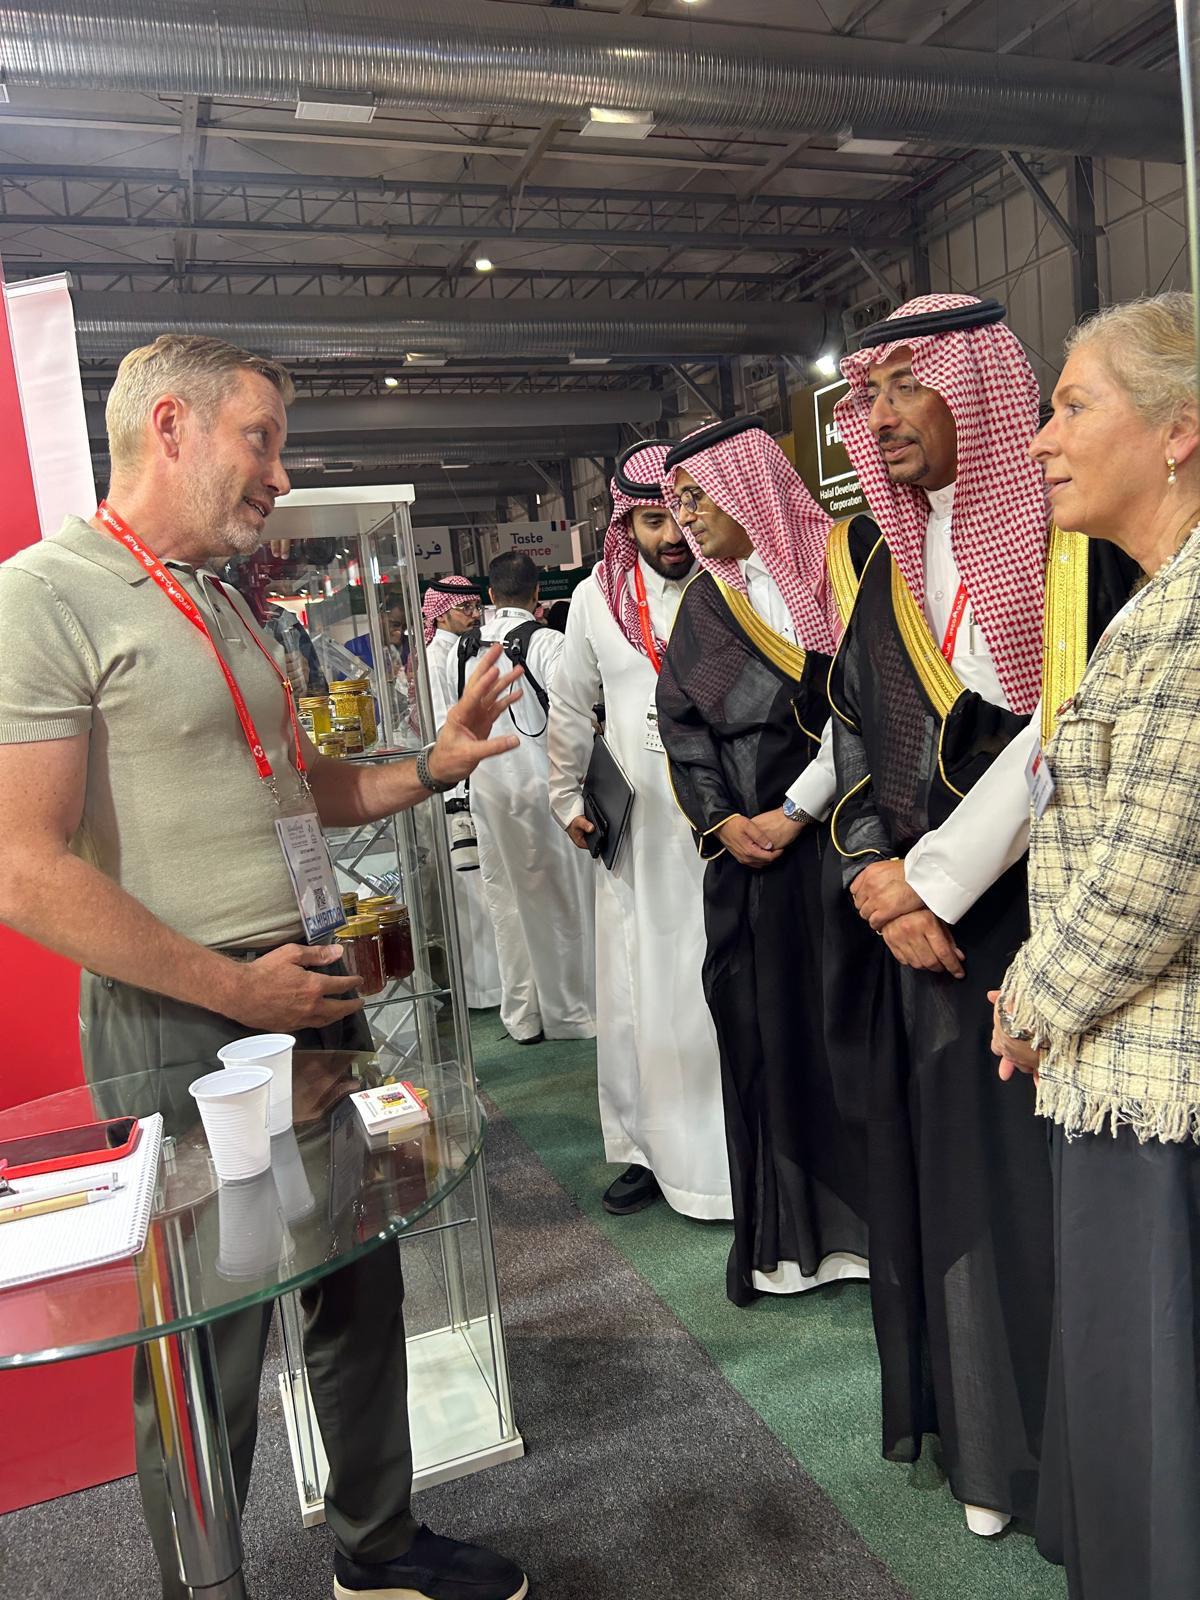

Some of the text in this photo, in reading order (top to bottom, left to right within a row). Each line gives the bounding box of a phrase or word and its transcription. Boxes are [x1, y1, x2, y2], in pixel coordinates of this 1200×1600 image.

[825, 421, 842, 446] H
[820, 482, 861, 500] Halal Develop
[830, 496, 862, 511] Corporation
[509, 532, 543, 544] Taste
[414, 541, 441, 560] فرن
[175, 592, 191, 611] IFFCO
